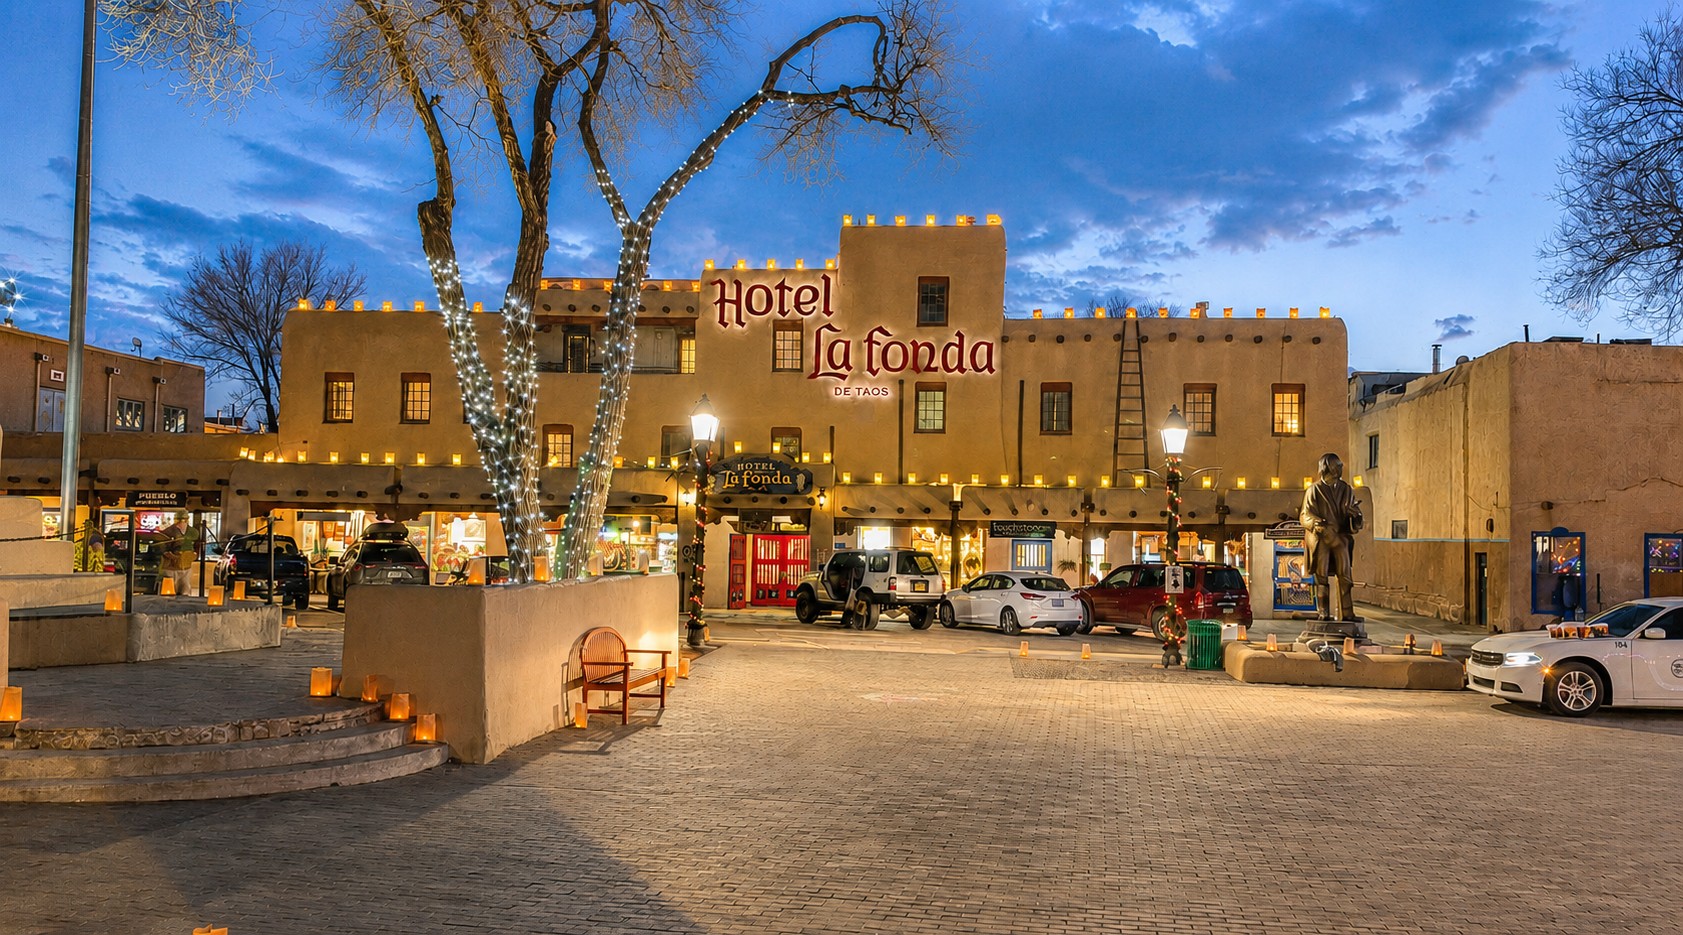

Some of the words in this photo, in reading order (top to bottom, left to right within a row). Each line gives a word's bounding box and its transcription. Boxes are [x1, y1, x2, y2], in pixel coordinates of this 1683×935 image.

[710, 273, 834, 329] Hotel
[807, 322, 853, 381] La
[834, 387, 851, 396] DE
[855, 387, 889, 396] TAOS
[737, 462, 776, 471] HOTEL
[719, 470, 740, 489] La
